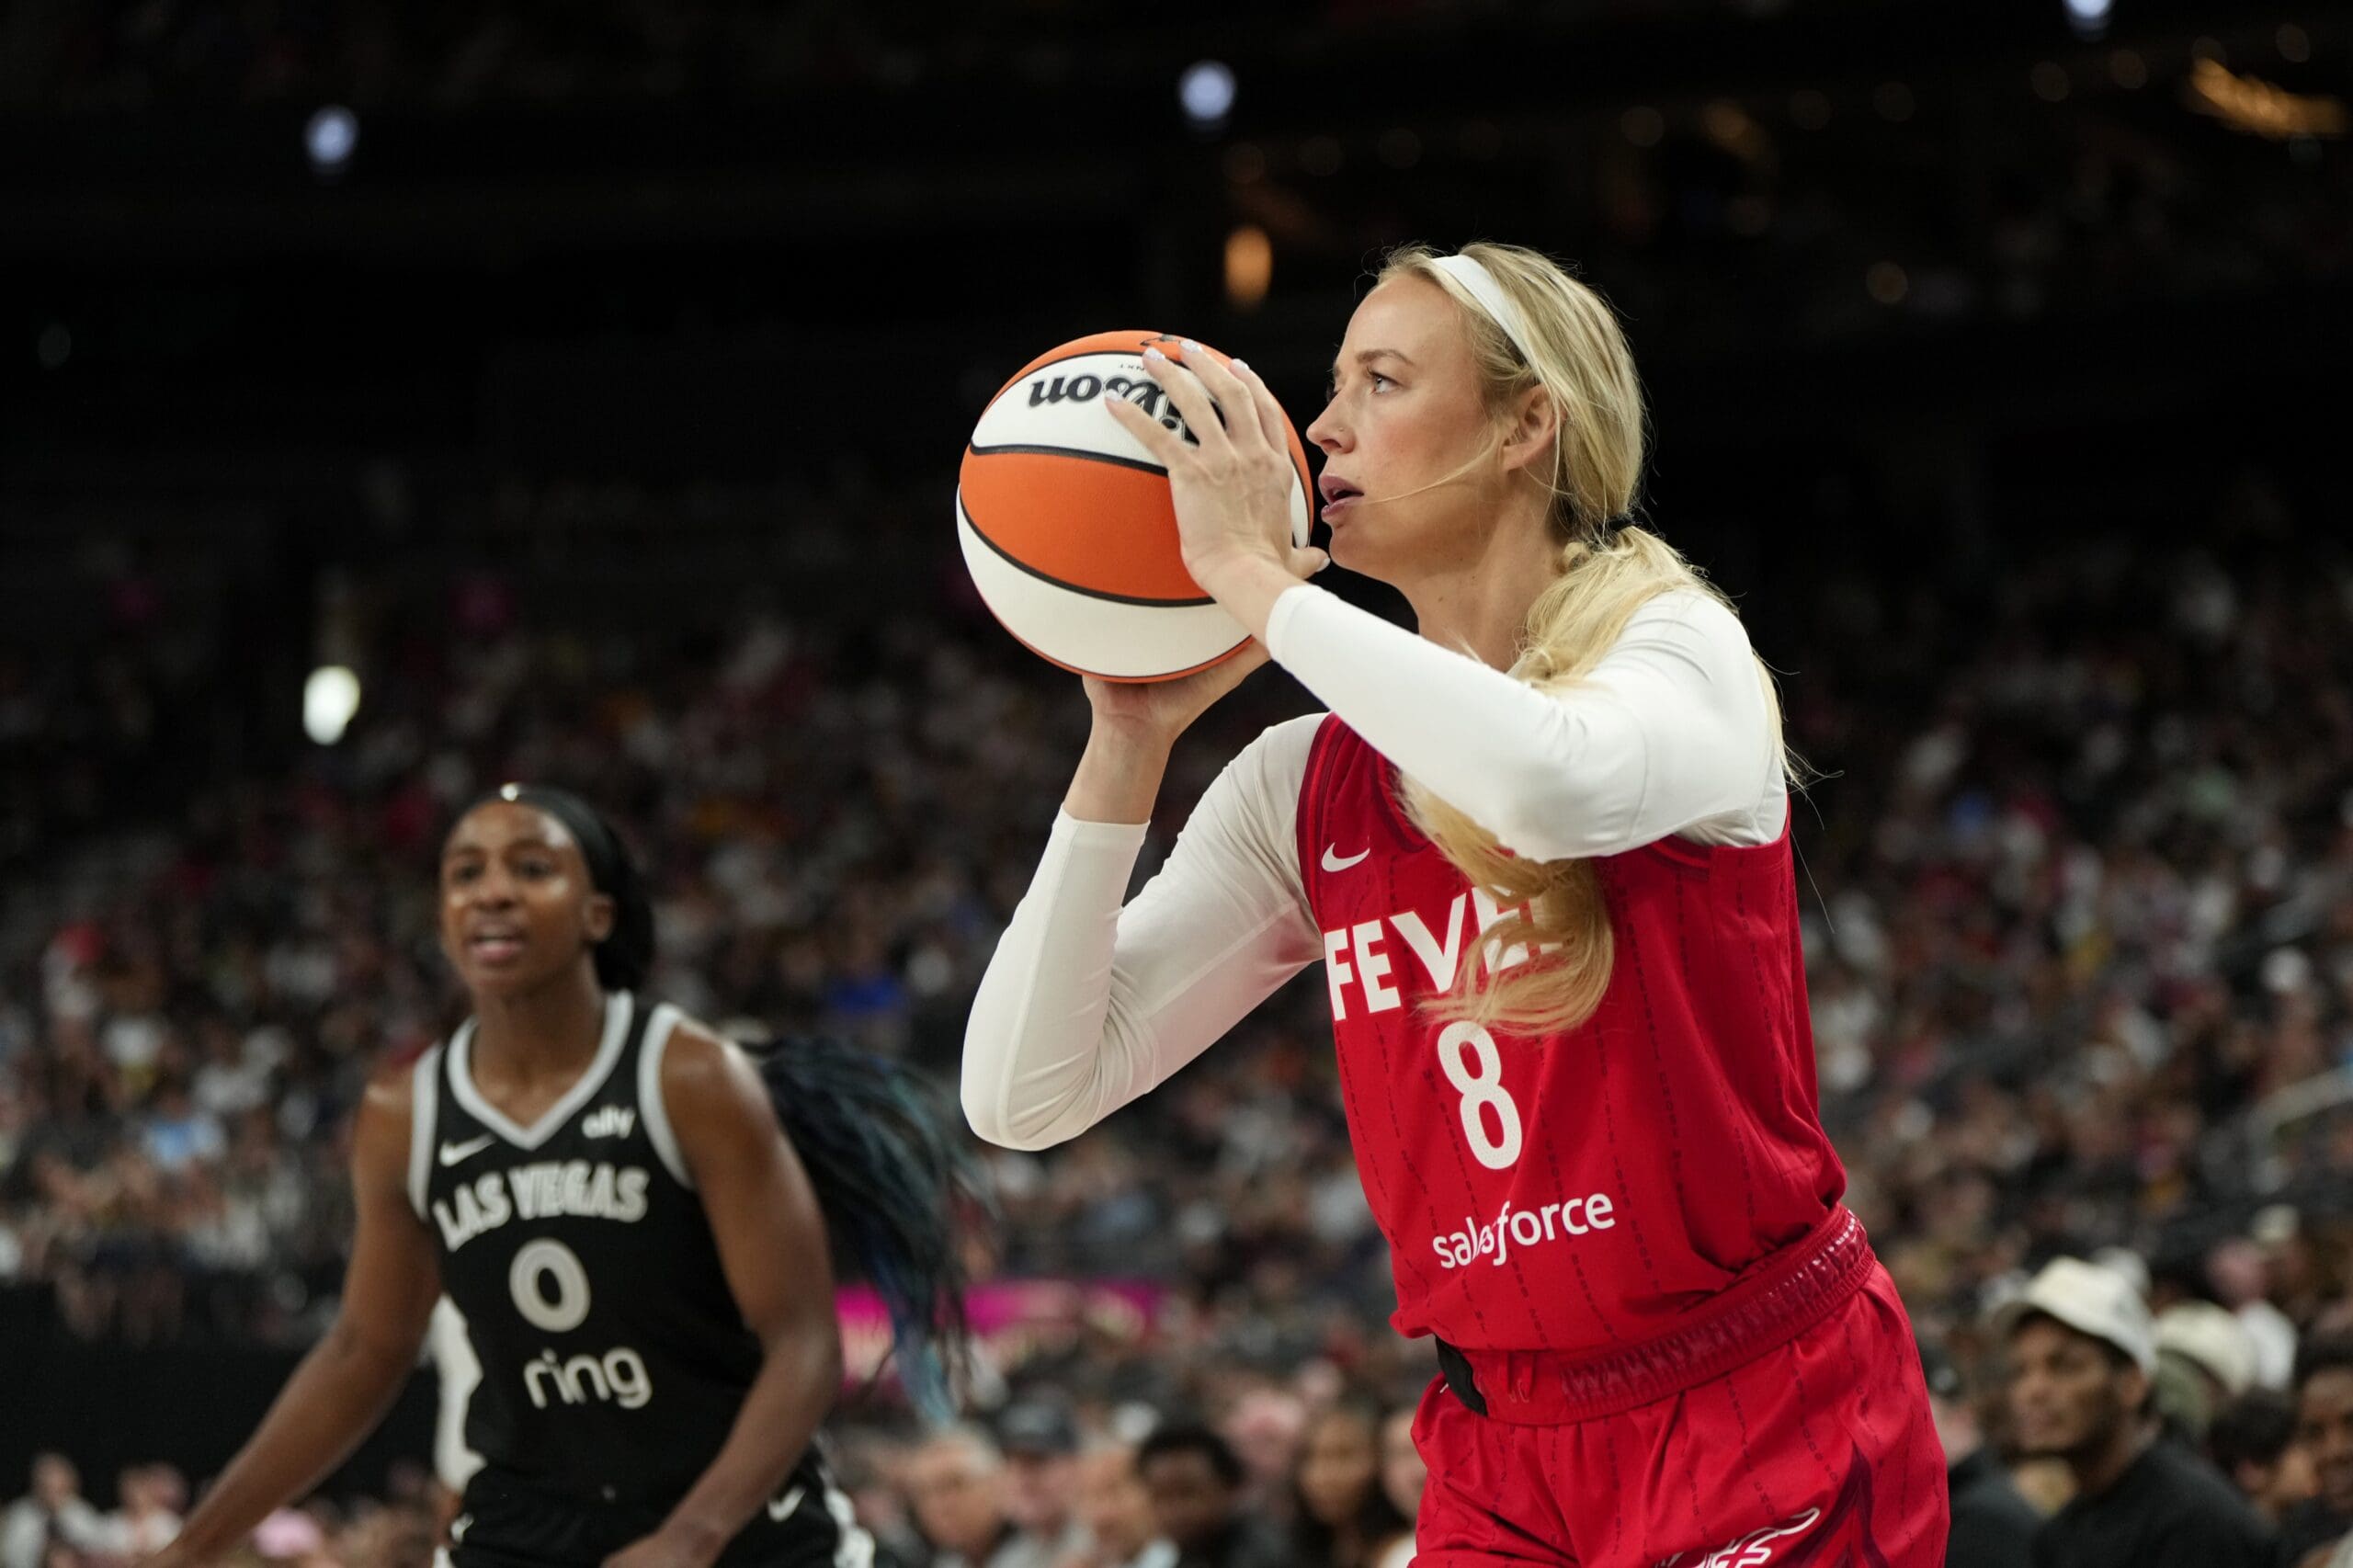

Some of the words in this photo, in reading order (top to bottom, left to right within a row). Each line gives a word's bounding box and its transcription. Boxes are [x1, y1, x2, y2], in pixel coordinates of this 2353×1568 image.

[1029, 374, 1226, 447] ilson
[1437, 1020, 1523, 1170] 8
[433, 1171, 511, 1251] LAS
[508, 1161, 648, 1222] VEGAS
[509, 1238, 591, 1332] 0
[524, 1348, 652, 1408] ring
